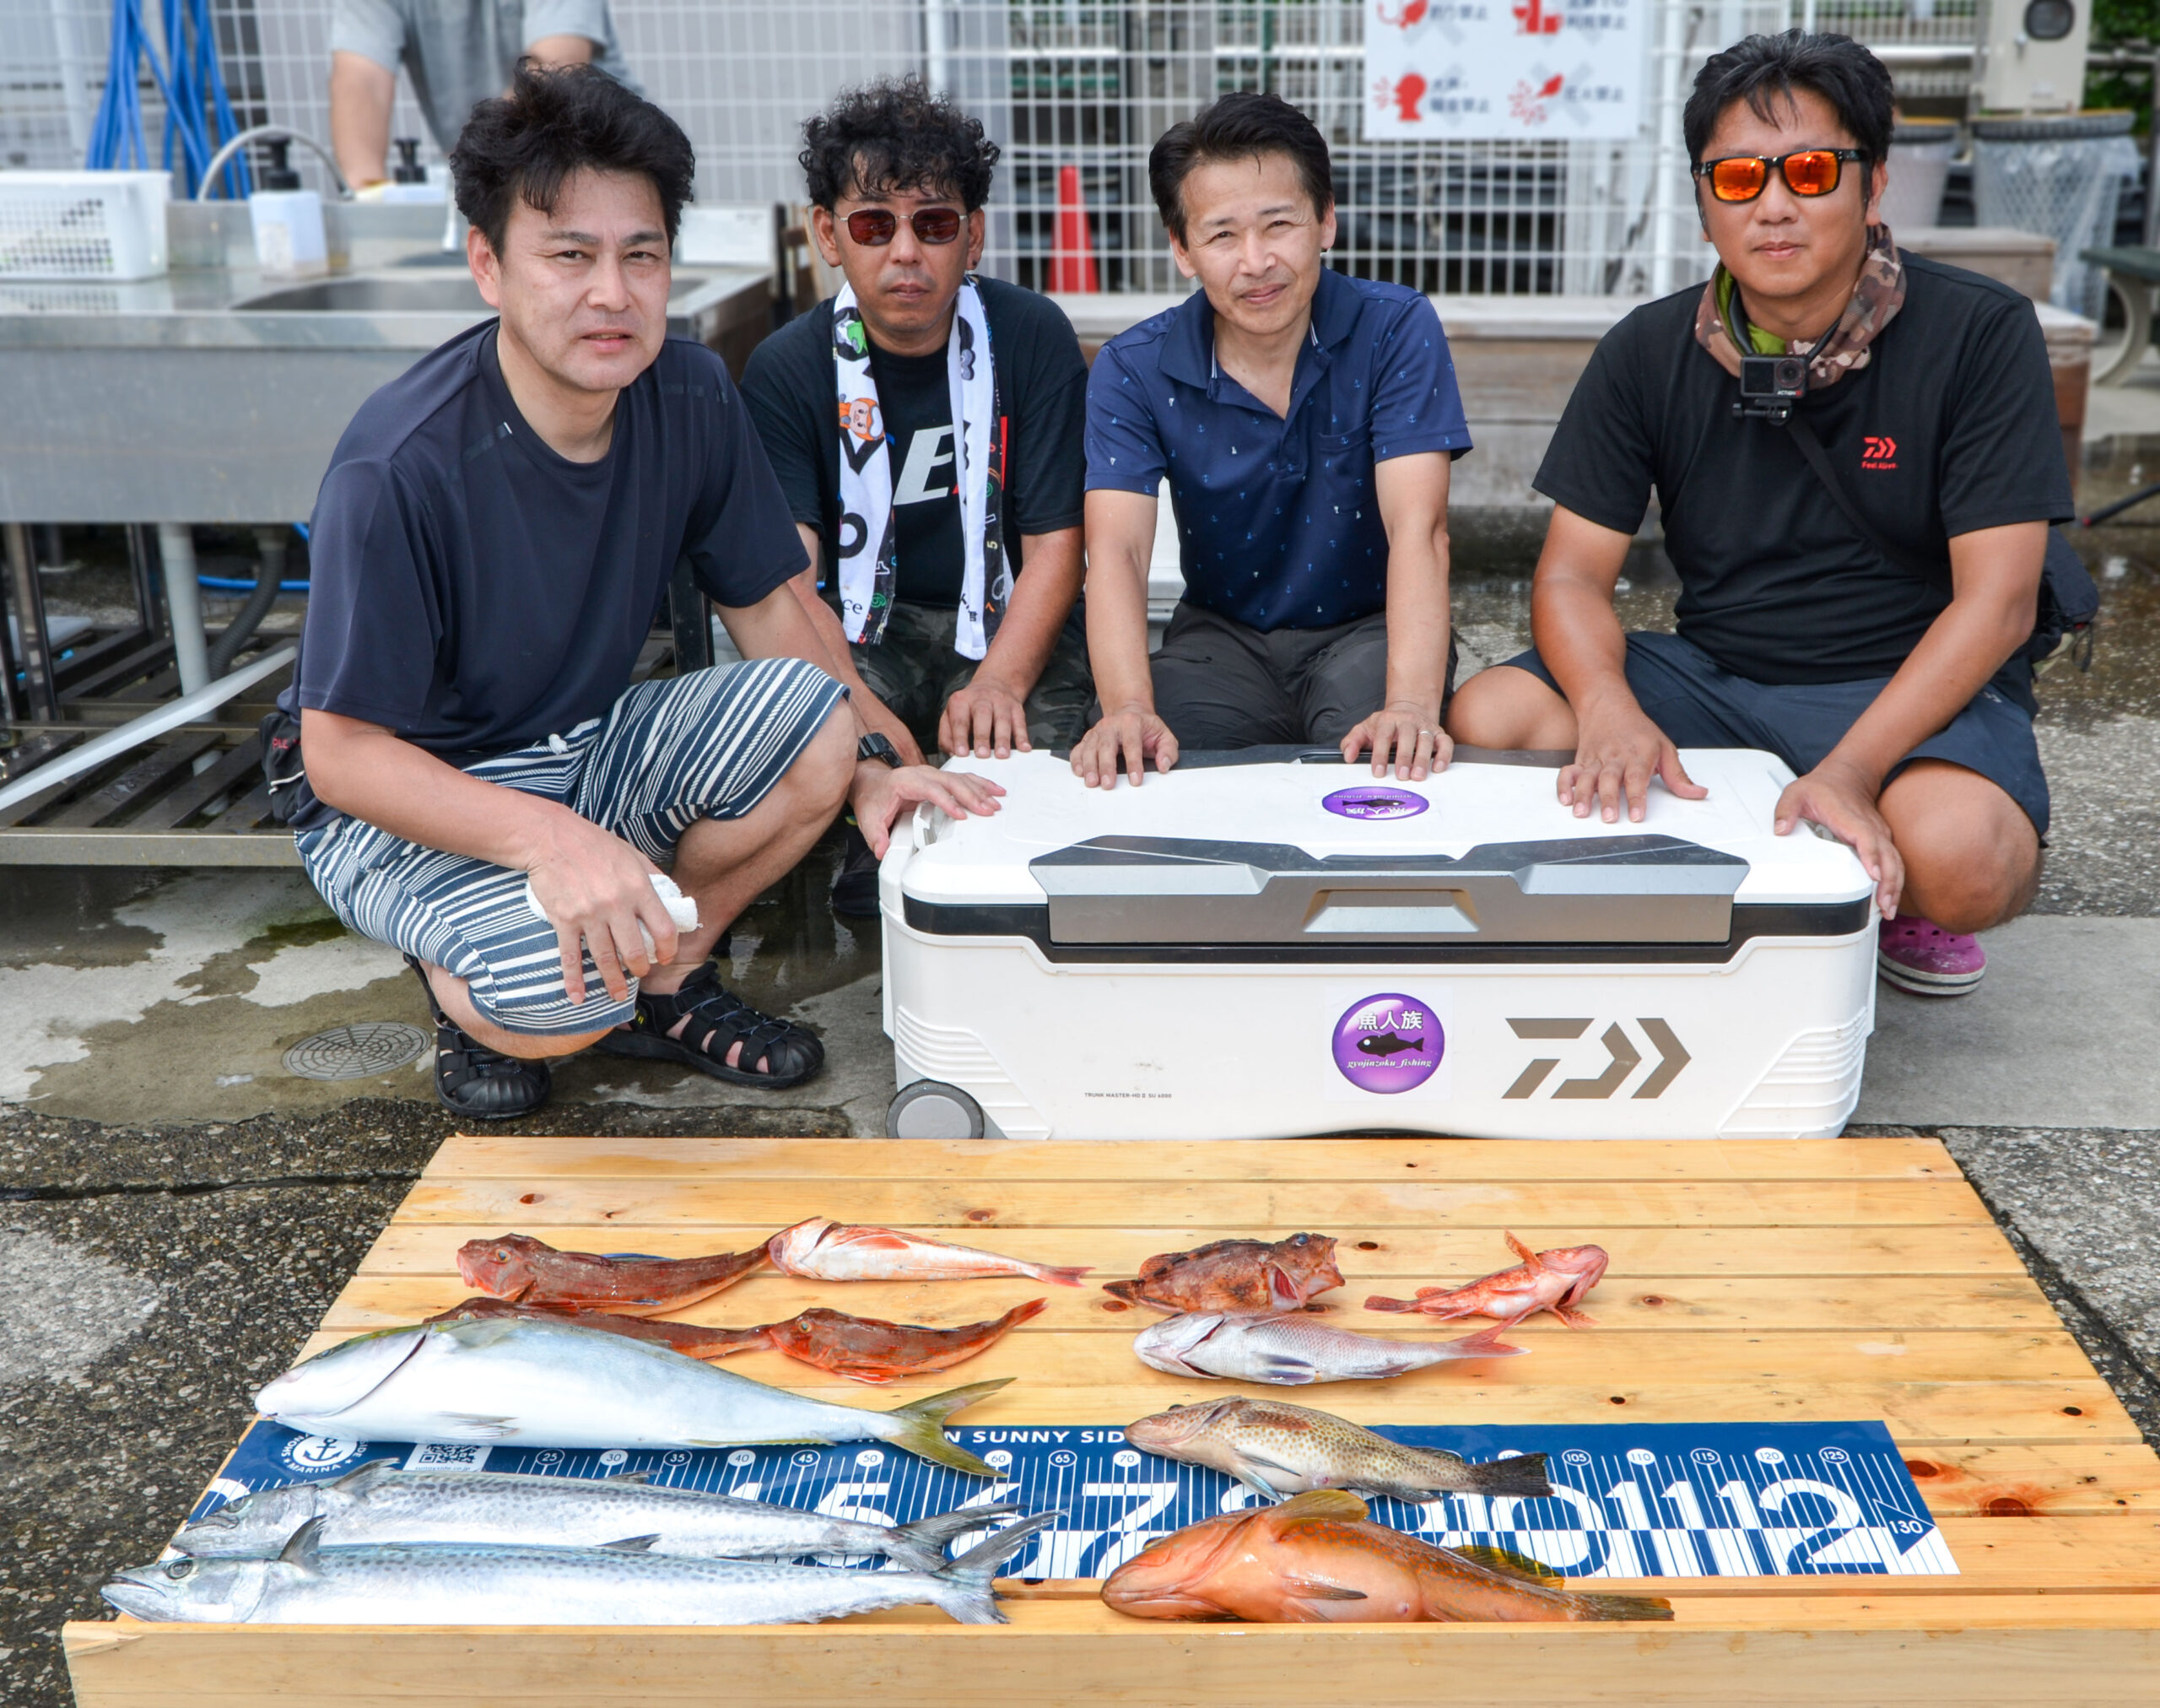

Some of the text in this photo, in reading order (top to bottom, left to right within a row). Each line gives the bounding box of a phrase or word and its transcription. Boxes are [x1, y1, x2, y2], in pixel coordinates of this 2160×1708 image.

[1358, 1009, 1423, 1030] 魚人族
[972, 1430, 1070, 1443] SUNNY
[1080, 1430, 1126, 1443] SID
[281, 1433, 309, 1457] SHON
[542, 1452, 558, 1462] 25
[606, 1452, 622, 1462] 30
[669, 1453, 685, 1462] 35
[735, 1454, 750, 1462] 40
[798, 1453, 814, 1463] 45
[862, 1454, 878, 1462] 50
[991, 1454, 1007, 1463] 60
[1055, 1454, 1071, 1463] 65
[1119, 1454, 1136, 1463] 70
[1566, 1453, 1587, 1462] 105
[1631, 1452, 1651, 1462] 110
[1694, 1451, 1716, 1462] 115
[1758, 1451, 1780, 1462] 120
[1823, 1451, 1844, 1461] 125
[288, 1462, 342, 1474] MARINA
[1888, 1519, 1925, 1536] 130
